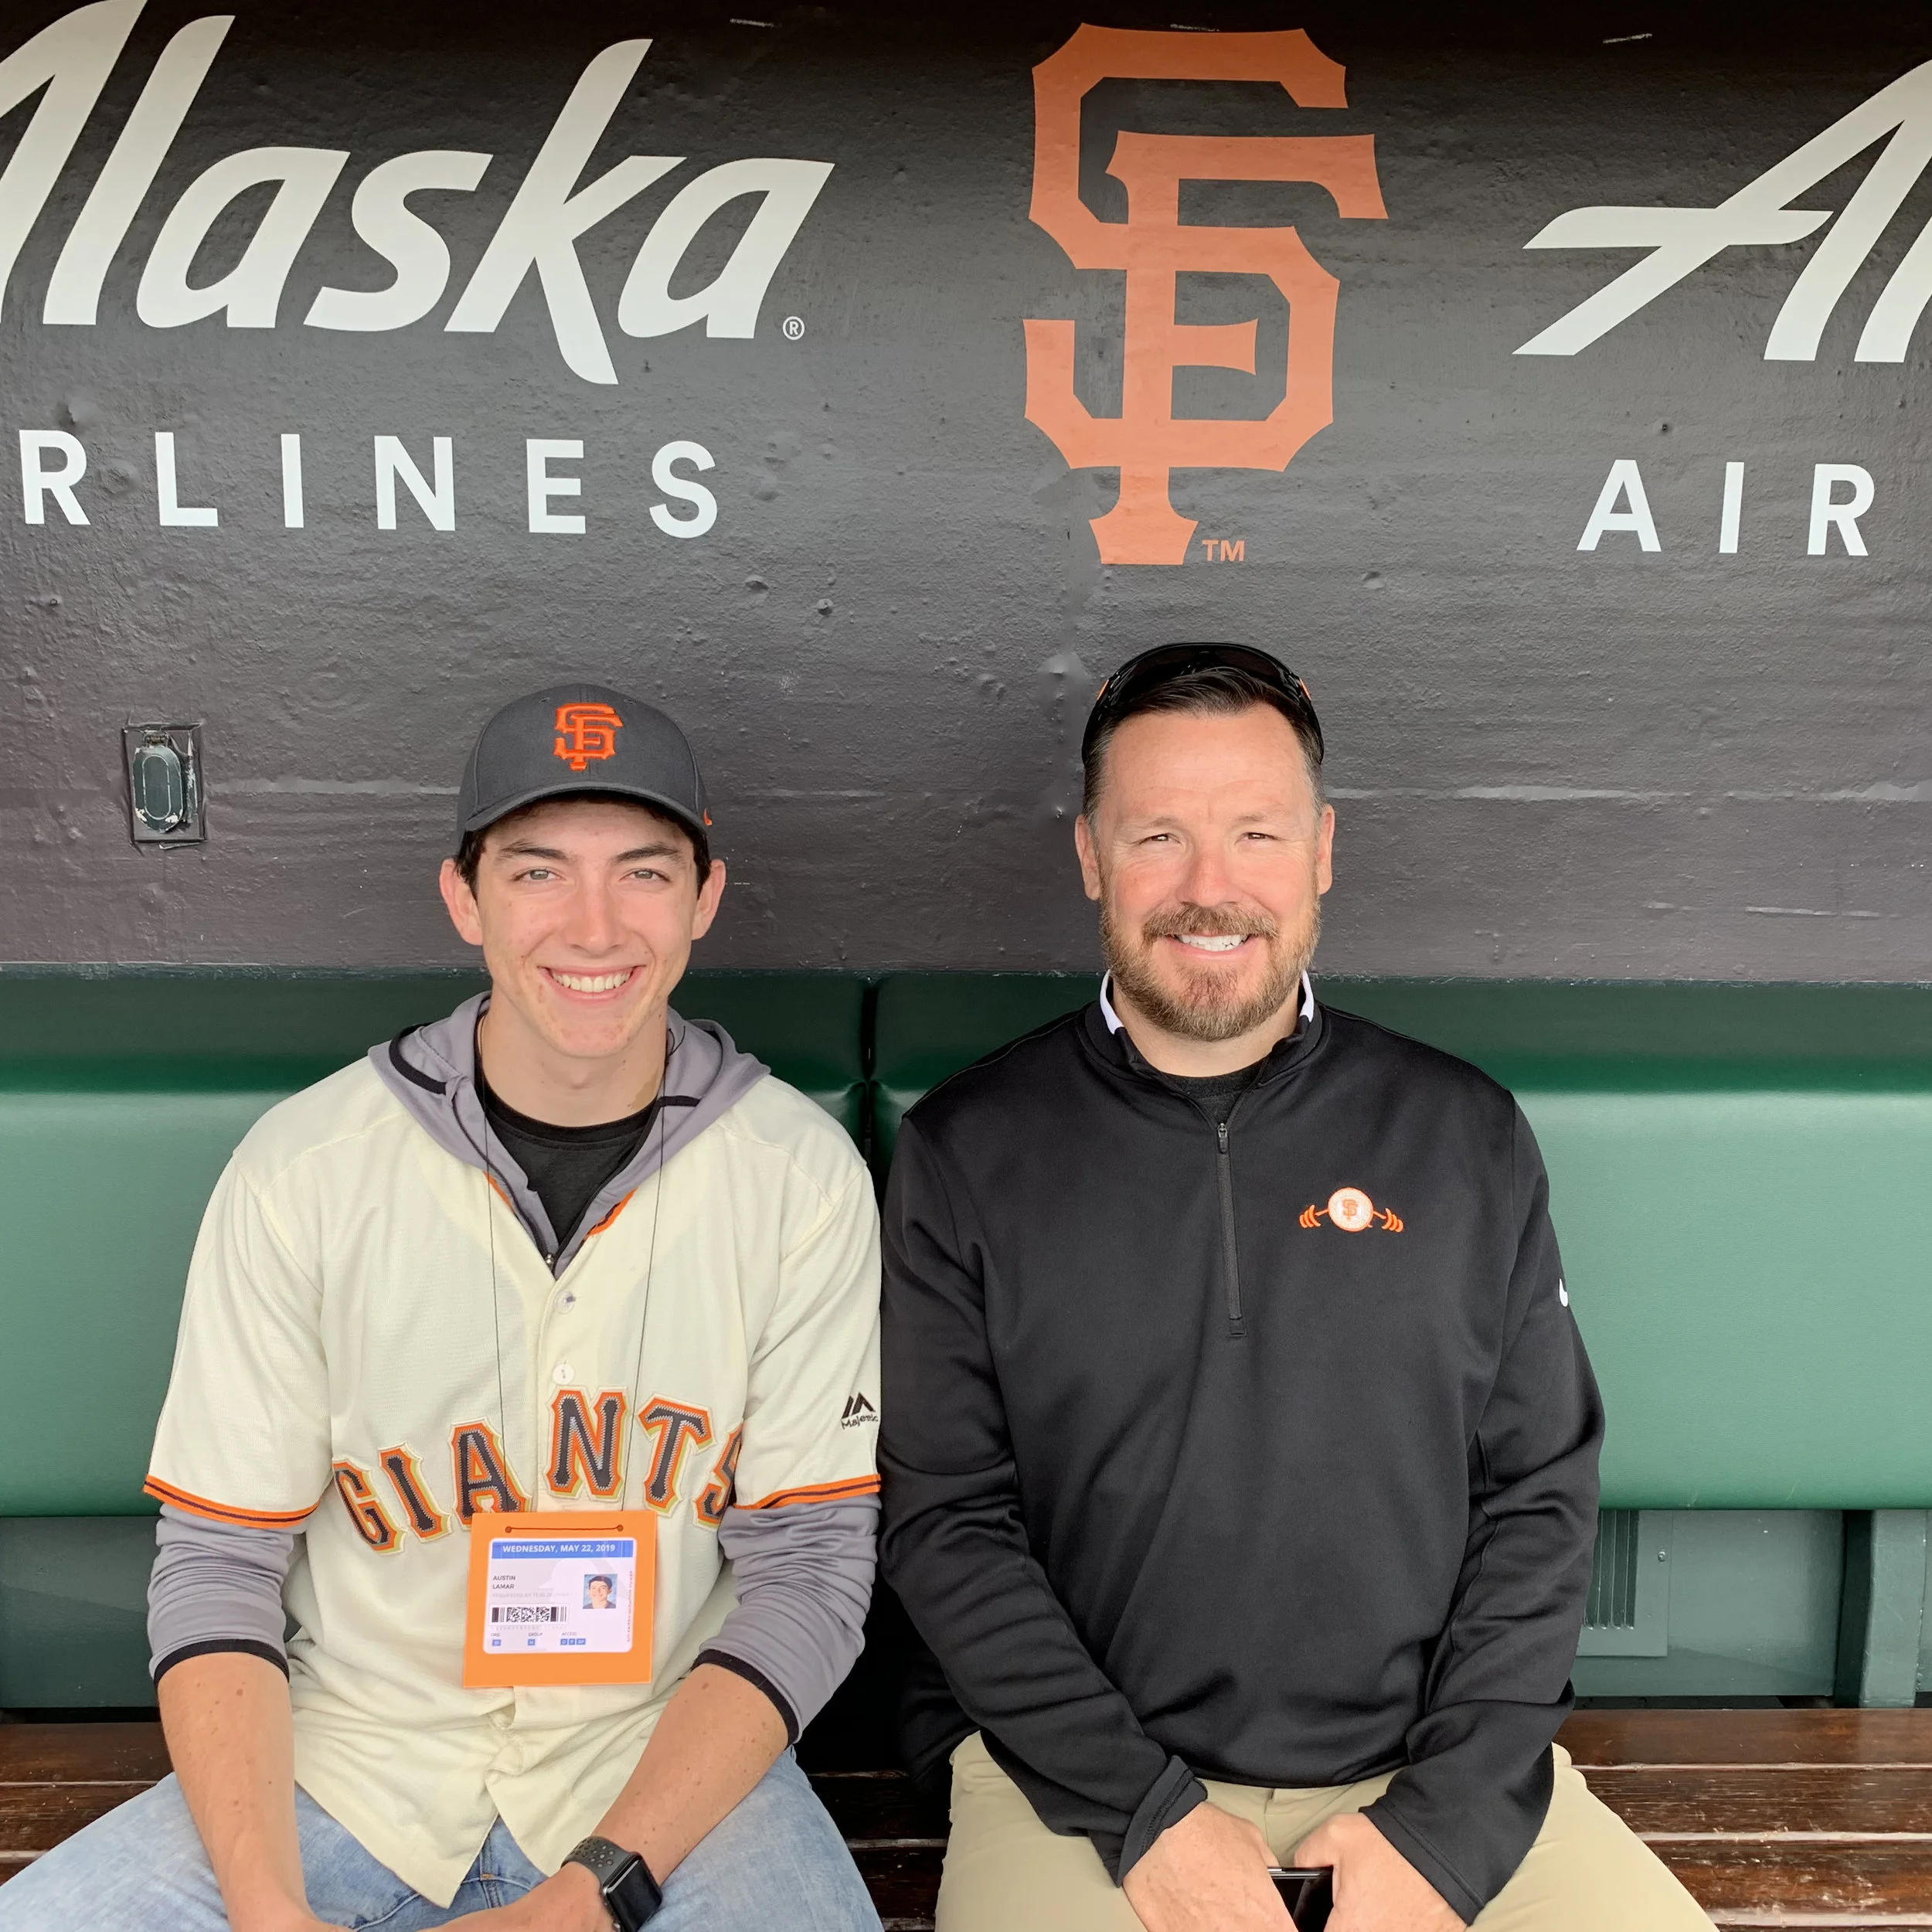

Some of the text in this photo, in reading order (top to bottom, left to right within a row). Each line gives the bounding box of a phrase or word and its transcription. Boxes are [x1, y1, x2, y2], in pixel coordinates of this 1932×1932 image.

[1577, 459, 1876, 556] AIR
[503, 1544, 616, 1553] WEDNESDAY, MAY 22, 2019
